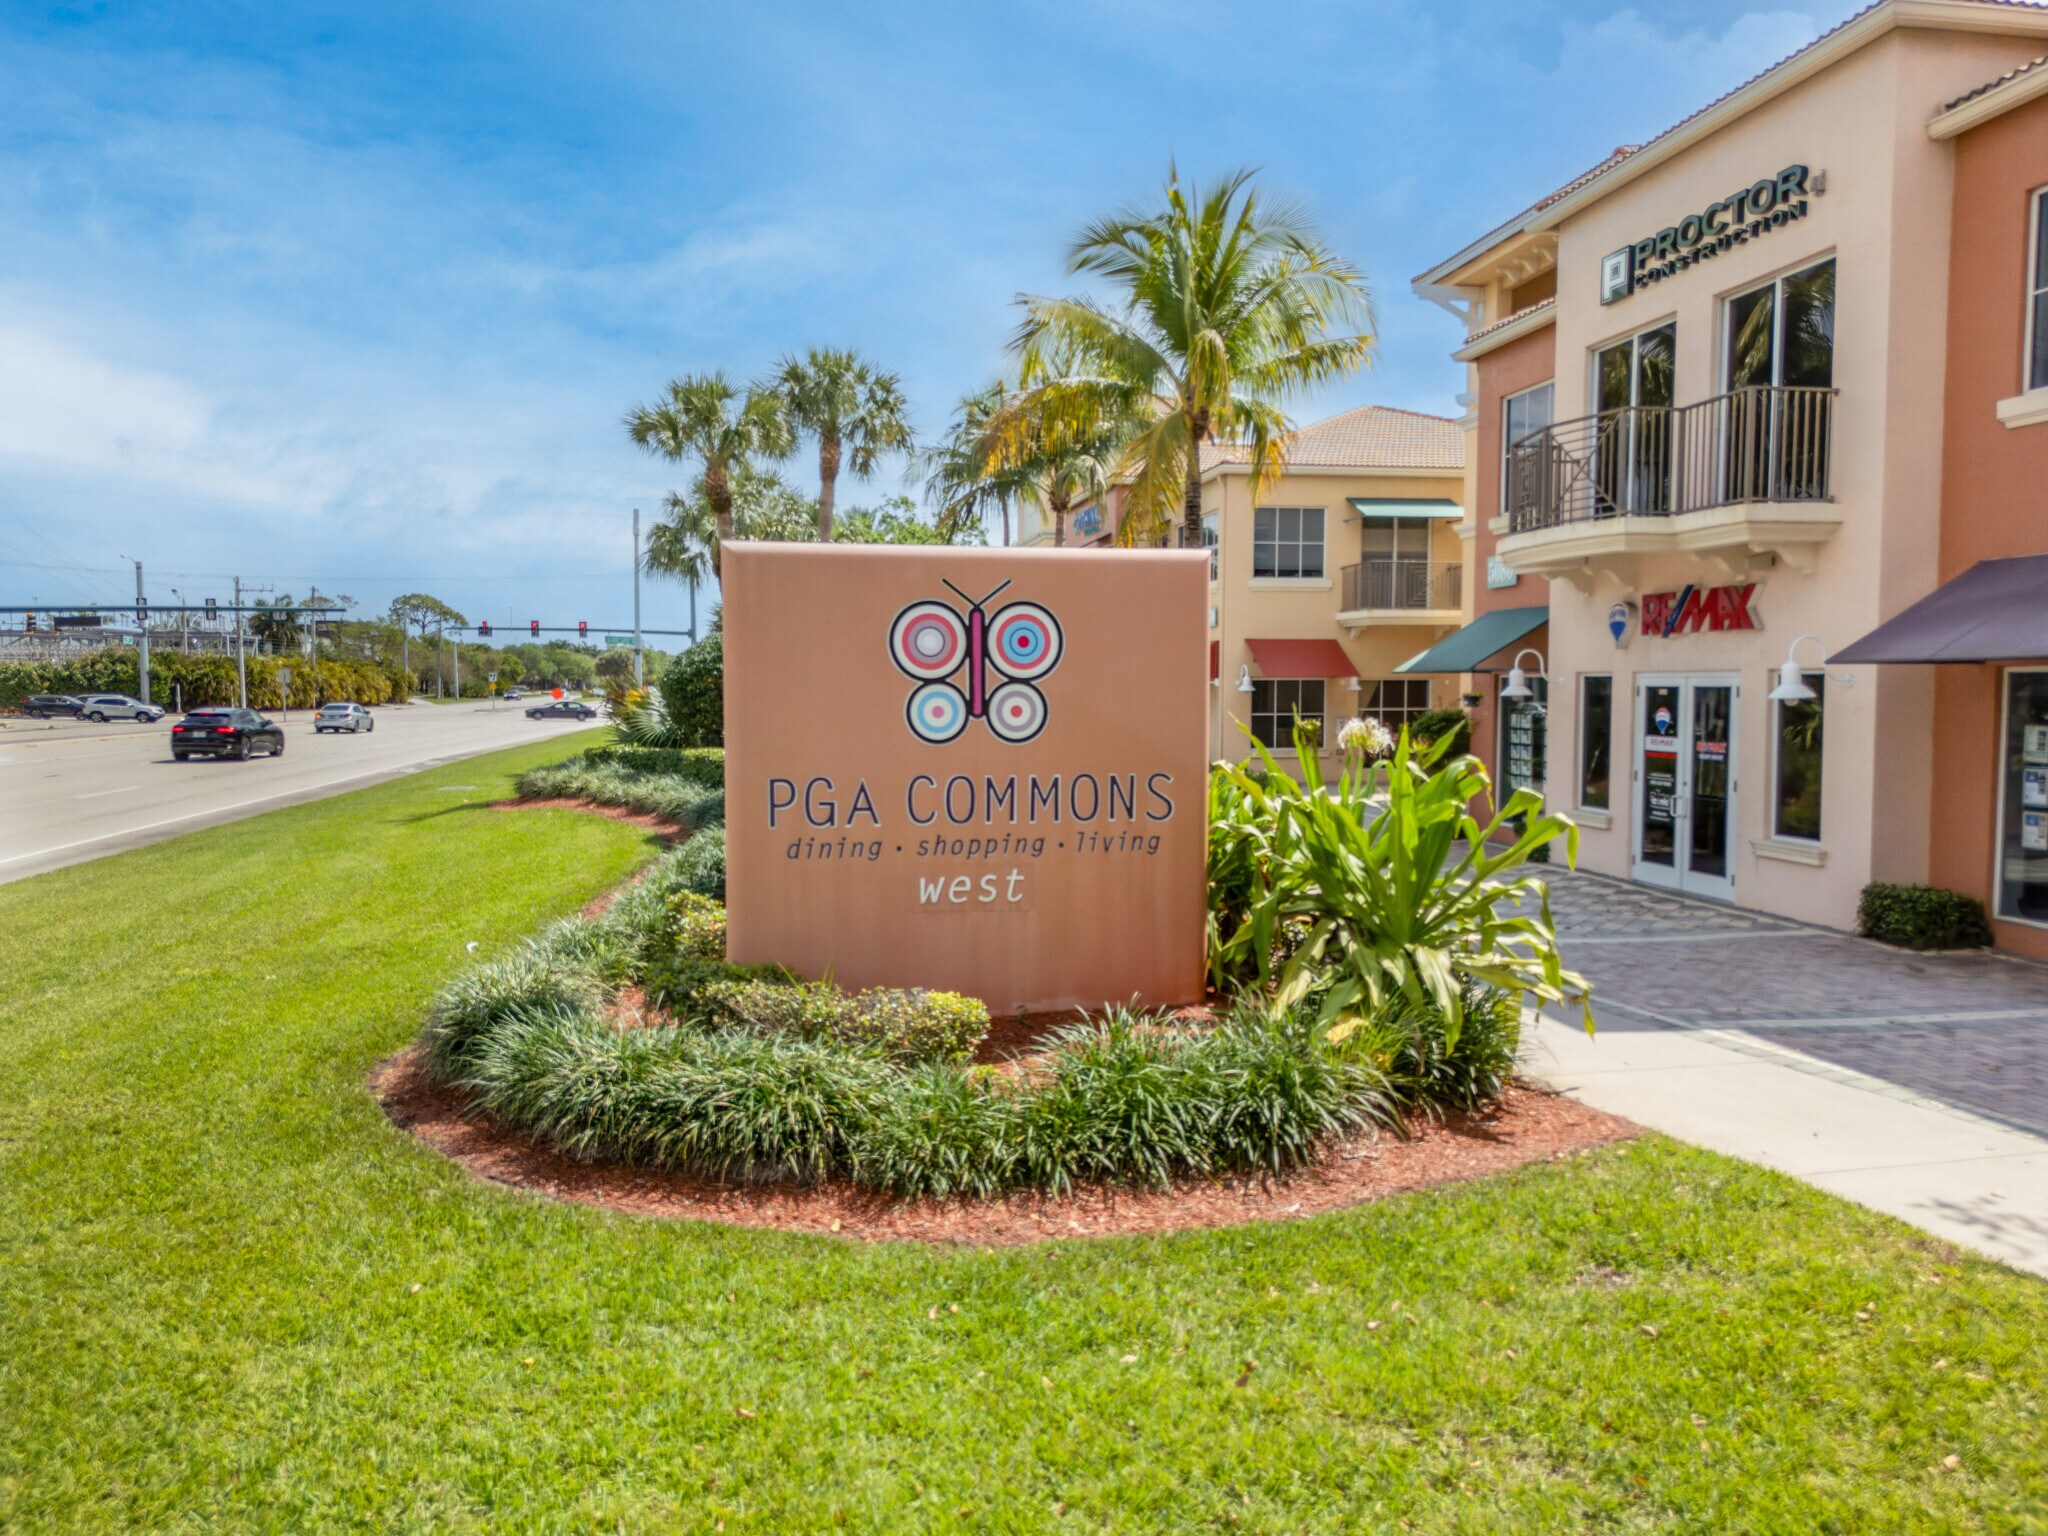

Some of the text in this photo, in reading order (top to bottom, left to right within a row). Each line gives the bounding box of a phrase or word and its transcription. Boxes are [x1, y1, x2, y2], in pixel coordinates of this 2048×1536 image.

[1634, 164, 1809, 270] PROCTOR
[1634, 200, 1808, 289] CONSTRUCTION
[1641, 583, 1764, 640] RE/MAX
[767, 772, 1175, 829] PGA COMMONS
[786, 831, 1162, 861] dining shopping living
[918, 868, 1026, 906] west
